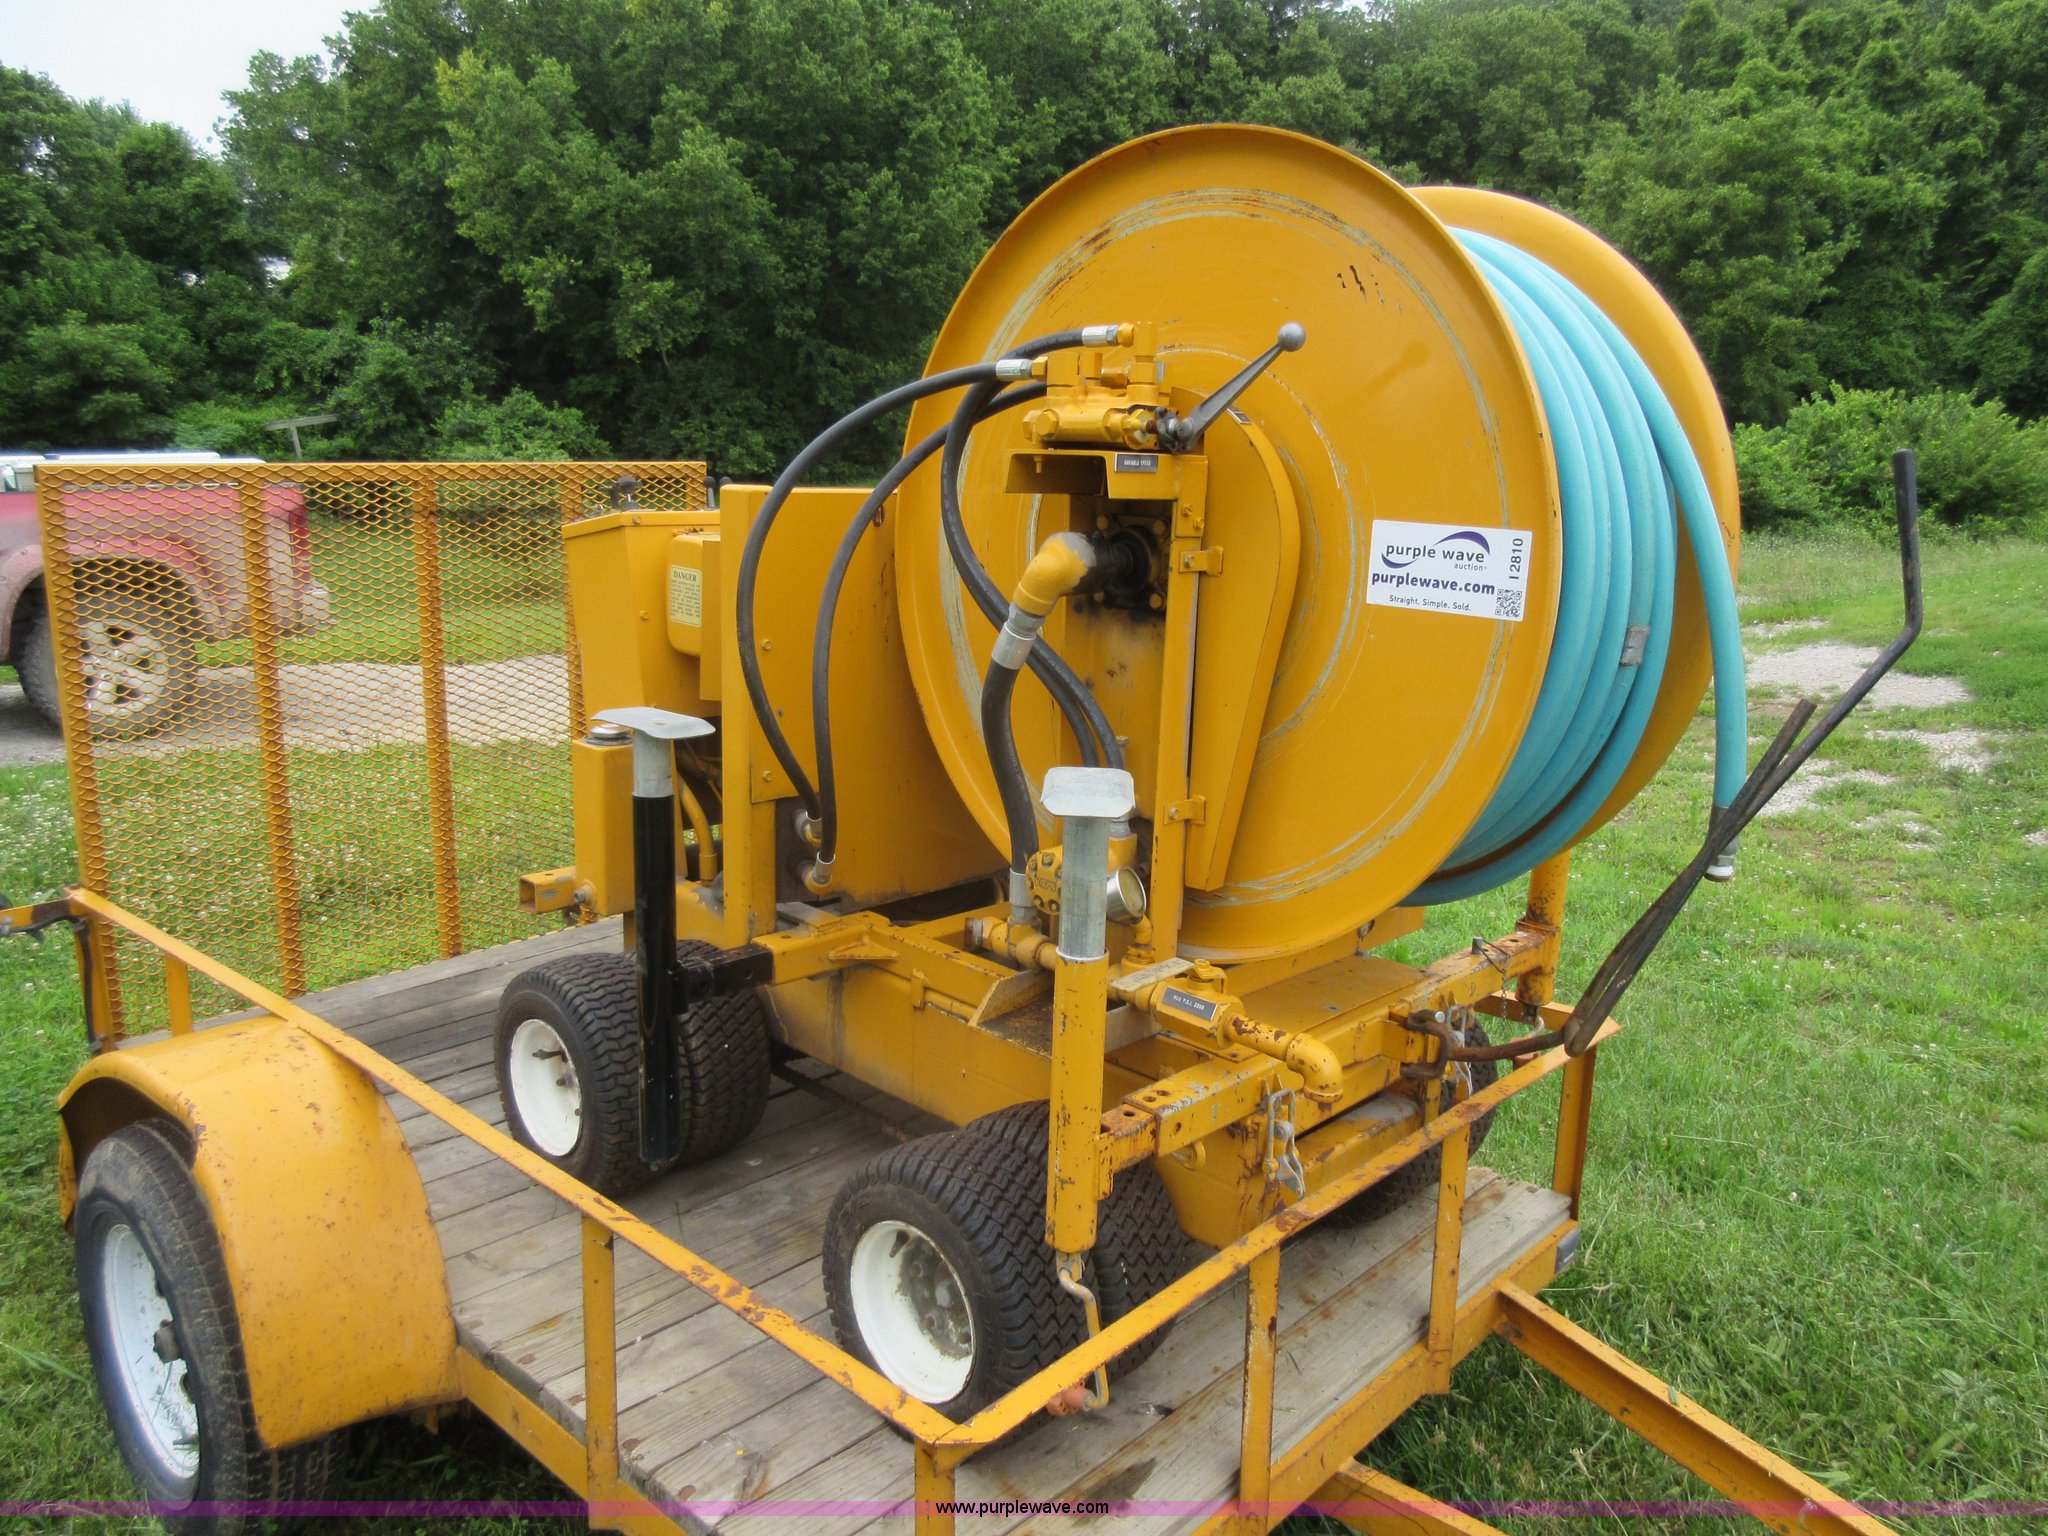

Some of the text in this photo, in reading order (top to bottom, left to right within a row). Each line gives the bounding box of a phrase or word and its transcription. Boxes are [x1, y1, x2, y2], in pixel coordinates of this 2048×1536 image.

[1385, 544, 1485, 563] purple wave
[1508, 537, 1524, 580] 12810
[1453, 562, 1483, 571] auction
[673, 570, 697, 582] DANGER
[1371, 572, 1495, 595] purplewave.com
[1389, 594, 1471, 611] Straight. Simple. Sold.
